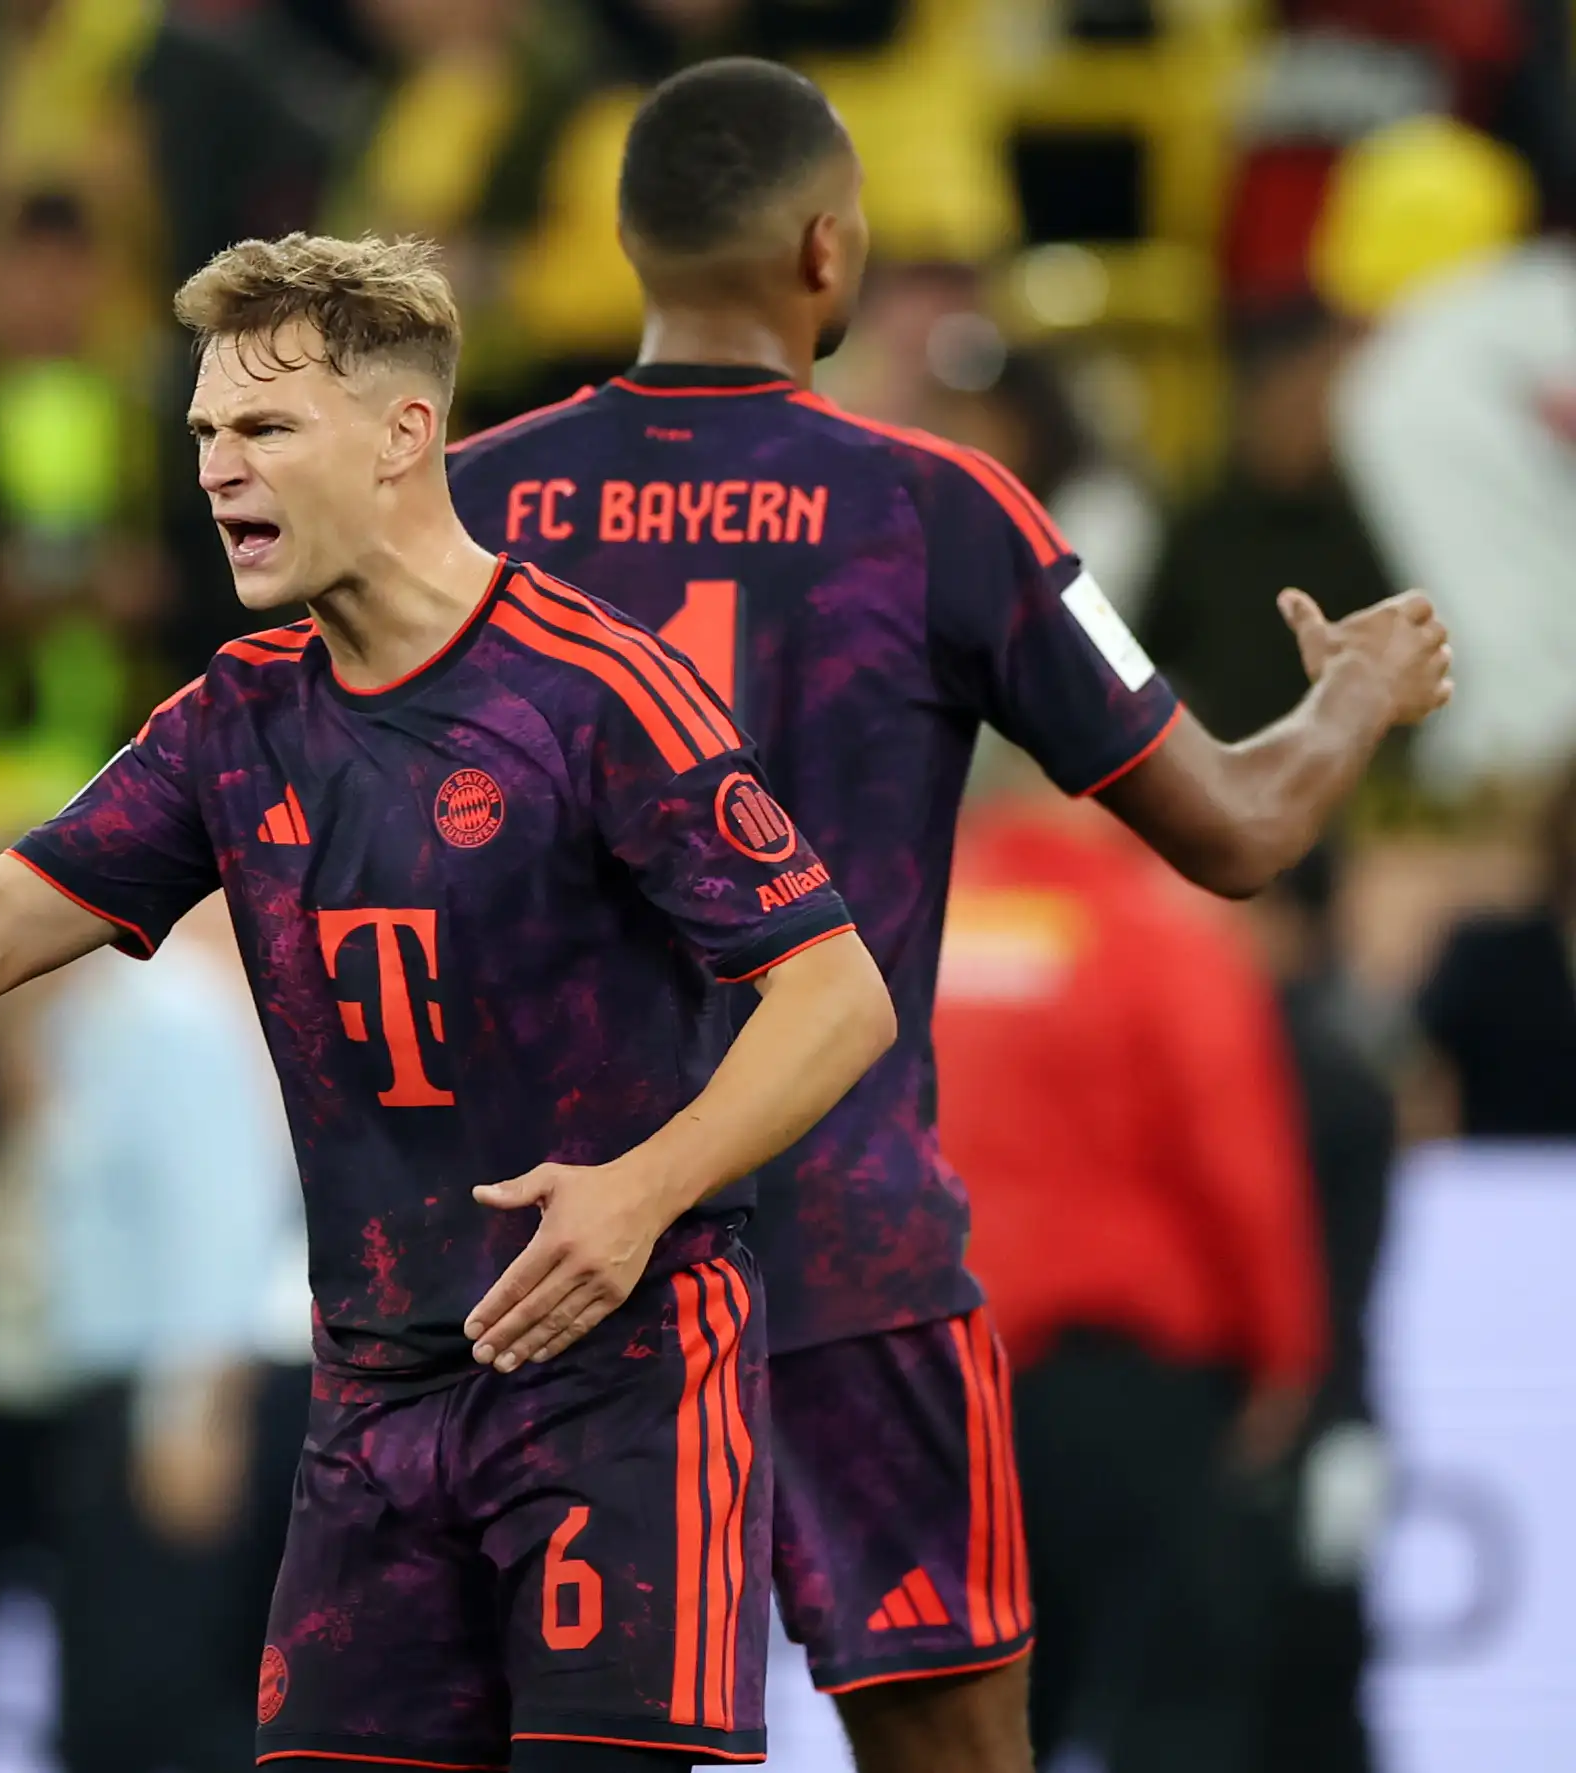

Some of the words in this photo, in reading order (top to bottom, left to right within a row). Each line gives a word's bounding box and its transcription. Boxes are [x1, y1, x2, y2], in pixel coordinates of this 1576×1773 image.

[505, 477, 578, 543] FC
[598, 479, 829, 545] BAYERN
[454, 772, 500, 804] BAYERN
[317, 907, 455, 1106] T
[541, 1505, 603, 1651] 6
